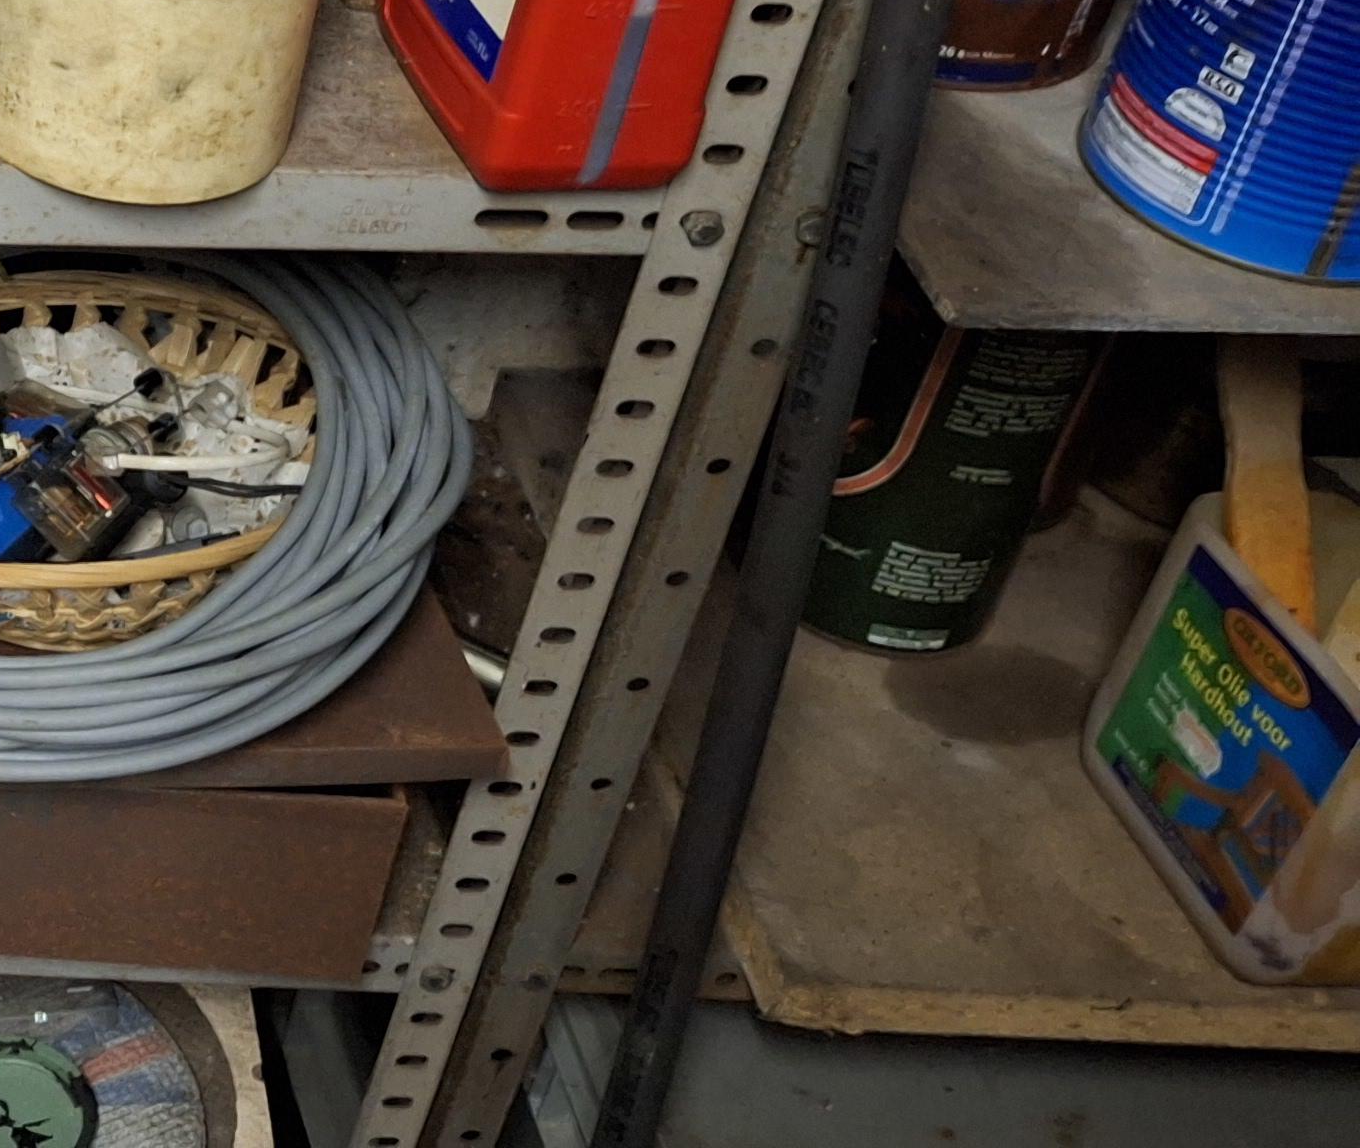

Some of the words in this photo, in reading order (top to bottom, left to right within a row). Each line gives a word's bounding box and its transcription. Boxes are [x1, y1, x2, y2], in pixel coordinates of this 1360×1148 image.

[1172, 607, 1218, 666] Super
[1217, 663, 1251, 708] Olie
[1251, 704, 1292, 751] voor
[1181, 651, 1254, 747] Hardhout
